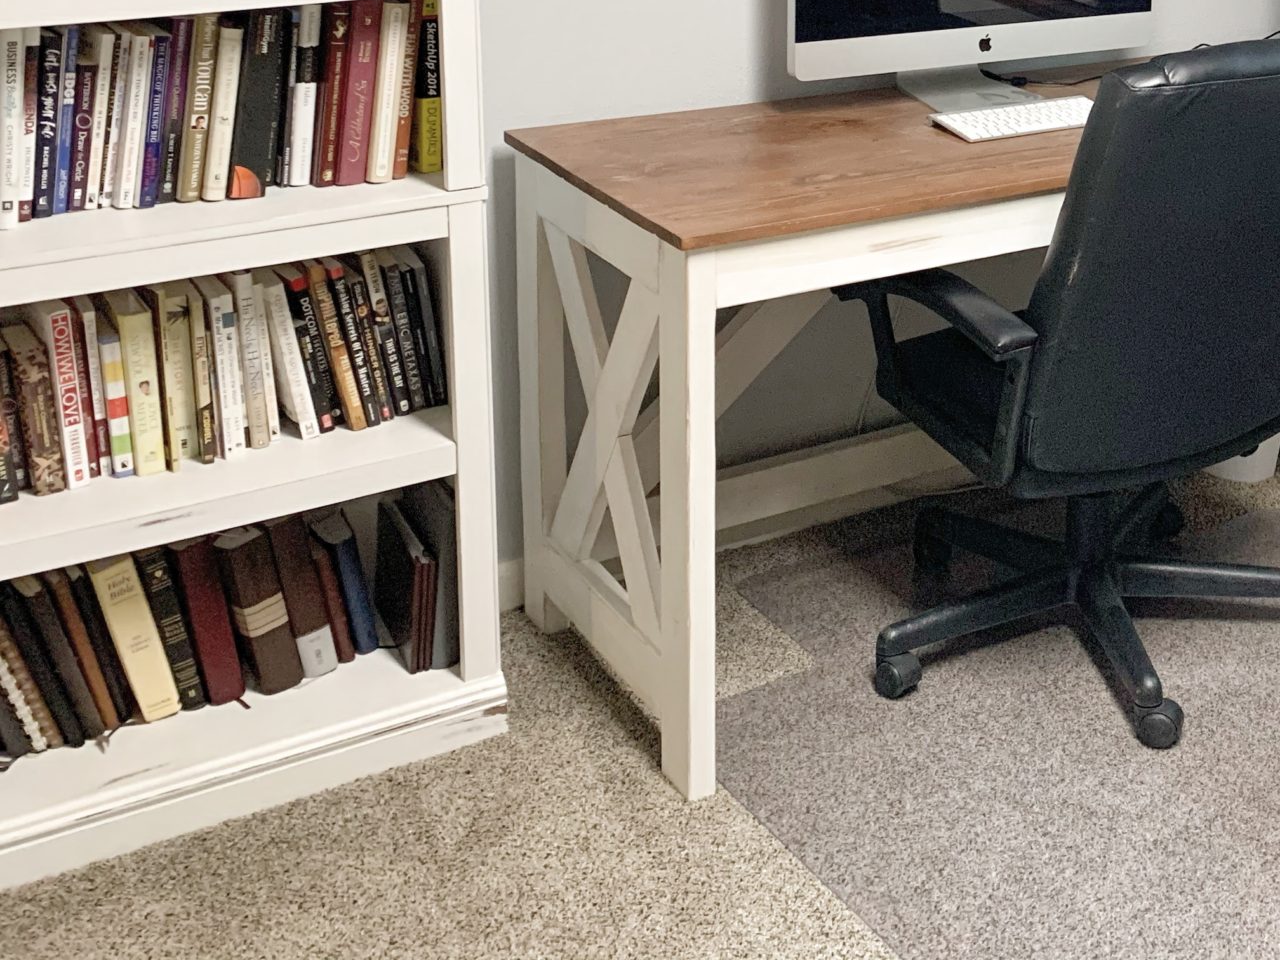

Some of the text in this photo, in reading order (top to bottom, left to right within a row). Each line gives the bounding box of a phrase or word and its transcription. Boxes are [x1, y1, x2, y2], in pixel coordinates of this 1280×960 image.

[260, 14, 272, 54] IntelliGym
[5, 40, 18, 85] BUSINESS
[194, 60, 214, 85] You
[426, 22, 438, 96] SketchUp 2014
[63, 72, 75, 105] EDGE
[150, 42, 167, 143] THE MAGIC OF THINKING BIG
[193, 85, 212, 112] Can
[399, 86, 412, 118] WOOD
[77, 131, 88, 152] Draw
[426, 106, 438, 156] DUMMIES
[4, 125, 15, 187] CHRISTY WRIGHT
[41, 146, 51, 189] RACHEL HOLLIS
[75, 160, 86, 181] Circle
[241, 297, 253, 315] His
[335, 279, 351, 313] Speaking
[390, 278, 402, 304] MEN
[300, 297, 318, 337] DOTCOM
[342, 313, 358, 341] Secrets
[247, 350, 260, 369] Her
[353, 351, 364, 366] The
[385, 338, 404, 388] THIS IS THE DAY
[397, 311, 421, 390] ERIC METAXAS
[51, 313, 80, 426] HOW WE LOVE
[174, 359, 185, 391] STORY
[249, 370, 262, 399] Needs
[356, 366, 371, 396] Masters
[108, 575, 130, 591] Holy
